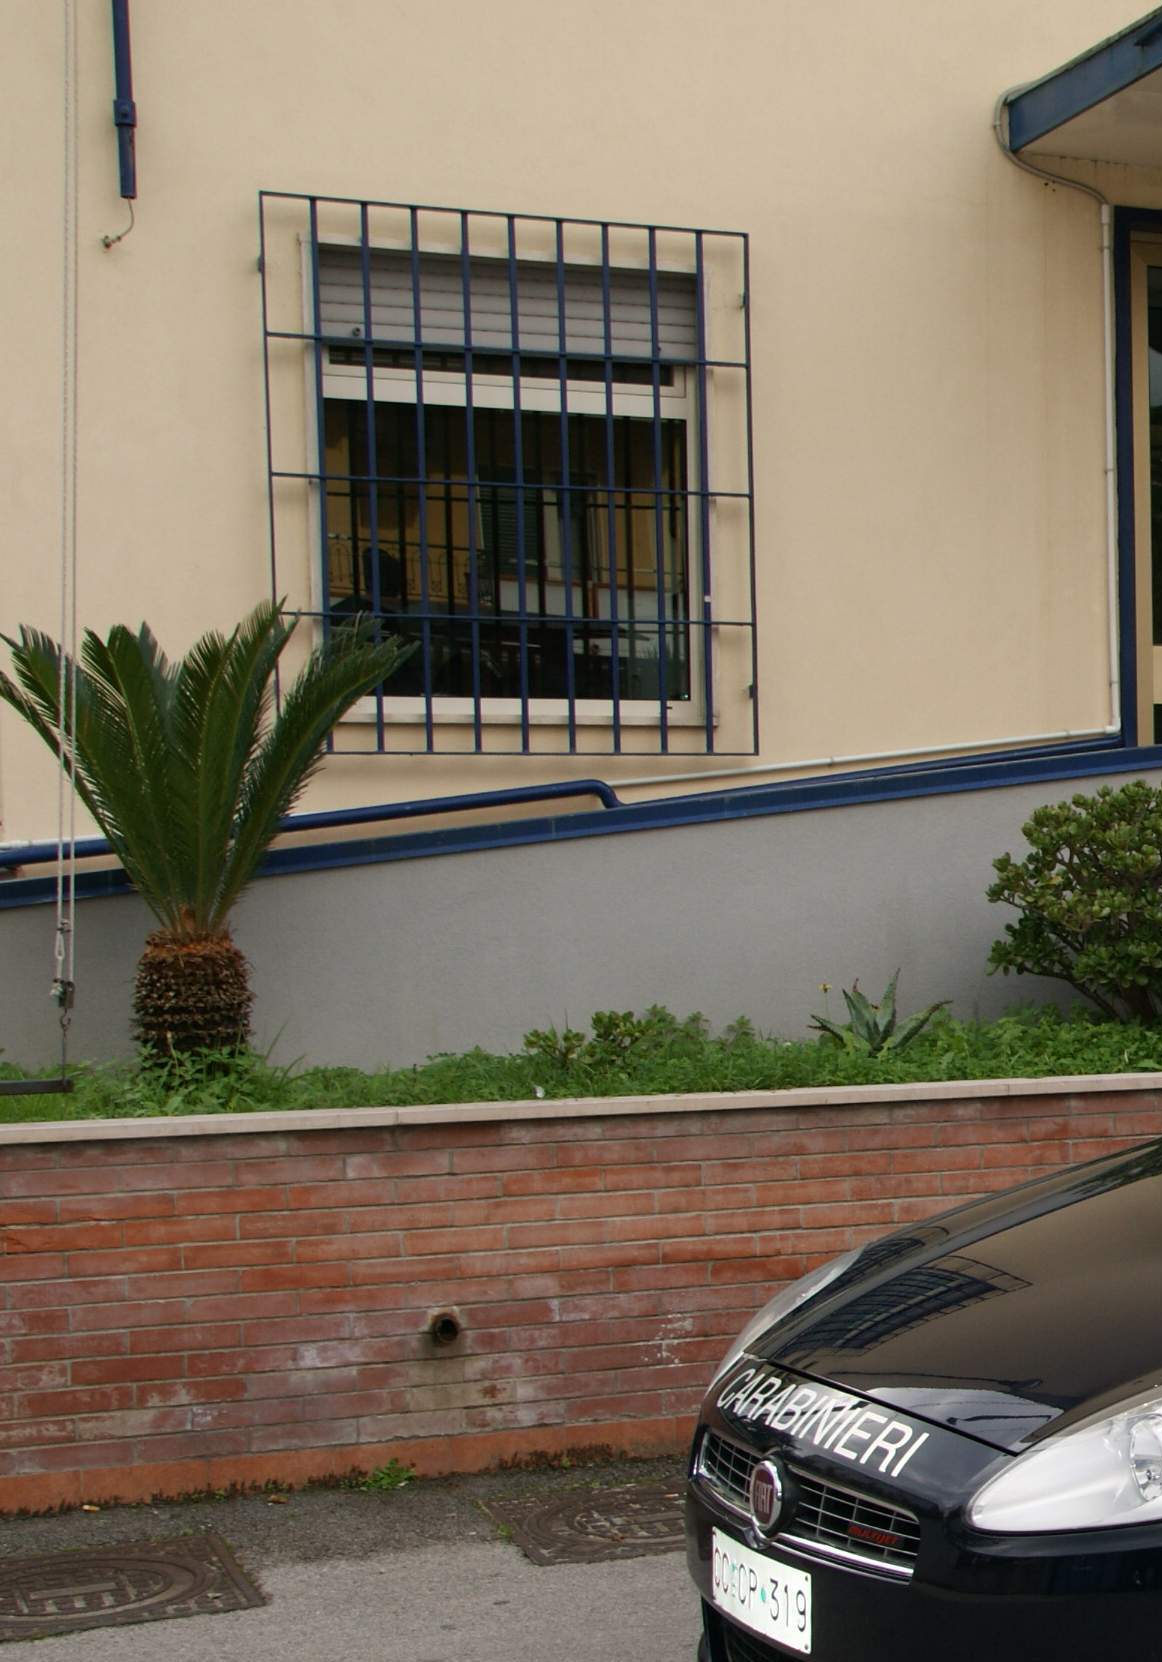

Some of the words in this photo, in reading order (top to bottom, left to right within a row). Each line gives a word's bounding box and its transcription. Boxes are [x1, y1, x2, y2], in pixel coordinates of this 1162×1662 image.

[716, 1368, 930, 1477] CARABINIERI
[752, 1480, 773, 1514] FIAT
[714, 1547, 730, 1594] CC
[738, 1563, 758, 1609] CP
[769, 1578, 807, 1632] 319
